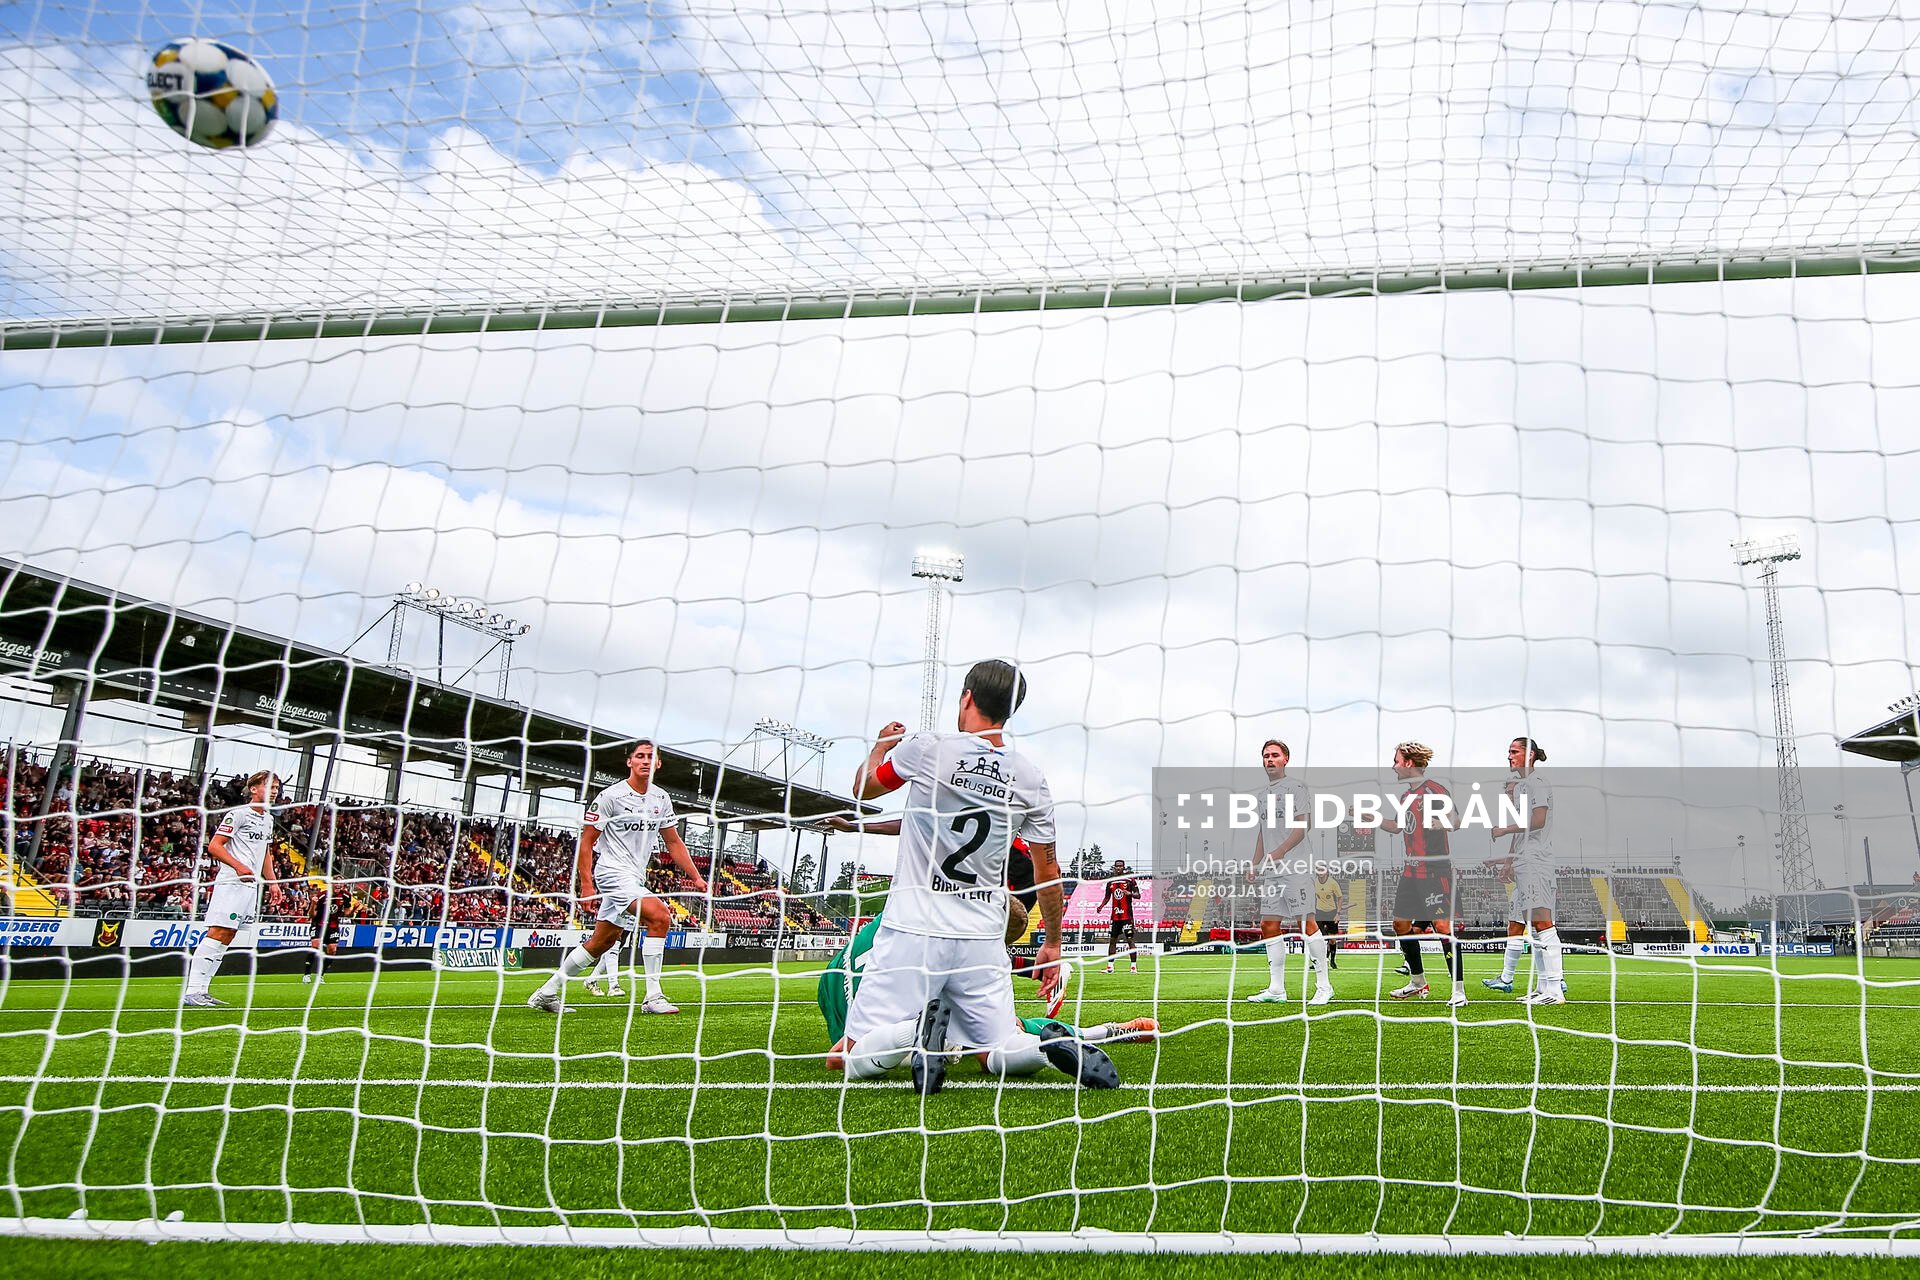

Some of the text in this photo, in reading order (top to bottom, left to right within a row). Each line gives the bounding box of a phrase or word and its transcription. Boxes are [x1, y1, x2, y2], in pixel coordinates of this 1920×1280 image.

[941, 806, 991, 884] 2
[150, 924, 208, 948] ahls
[373, 927, 497, 948] POLARIS
[1643, 943, 1685, 951] JemtBil
[1713, 945, 1750, 954] INAB
[1761, 944, 1832, 954] POLARIS
